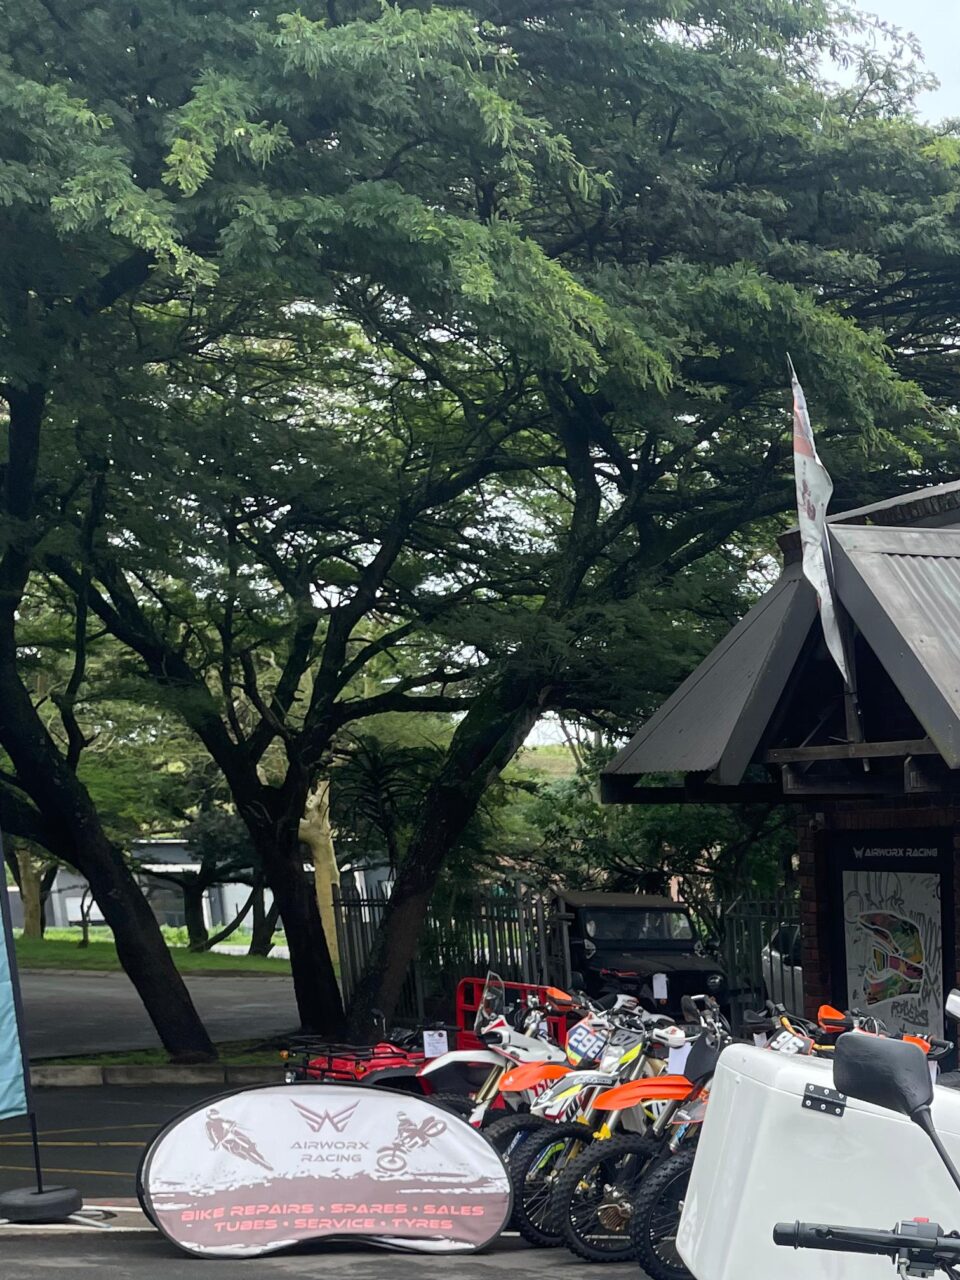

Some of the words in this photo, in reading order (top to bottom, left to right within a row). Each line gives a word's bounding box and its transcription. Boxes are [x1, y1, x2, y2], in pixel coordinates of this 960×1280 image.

[864, 848, 904, 857] AIRWORX
[905, 848, 938, 857] RACING
[290, 1140, 369, 1150] AIRWORX
[300, 1153, 362, 1163] RACING
[181, 1205, 224, 1222] BIKE
[230, 1203, 314, 1216] REPAIRS
[330, 1203, 408, 1215] SPARES
[424, 1204, 485, 1217] SALES
[214, 1220, 278, 1233] TUBES
[294, 1218, 375, 1229] SERVICE
[391, 1218, 453, 1230] TYRES
